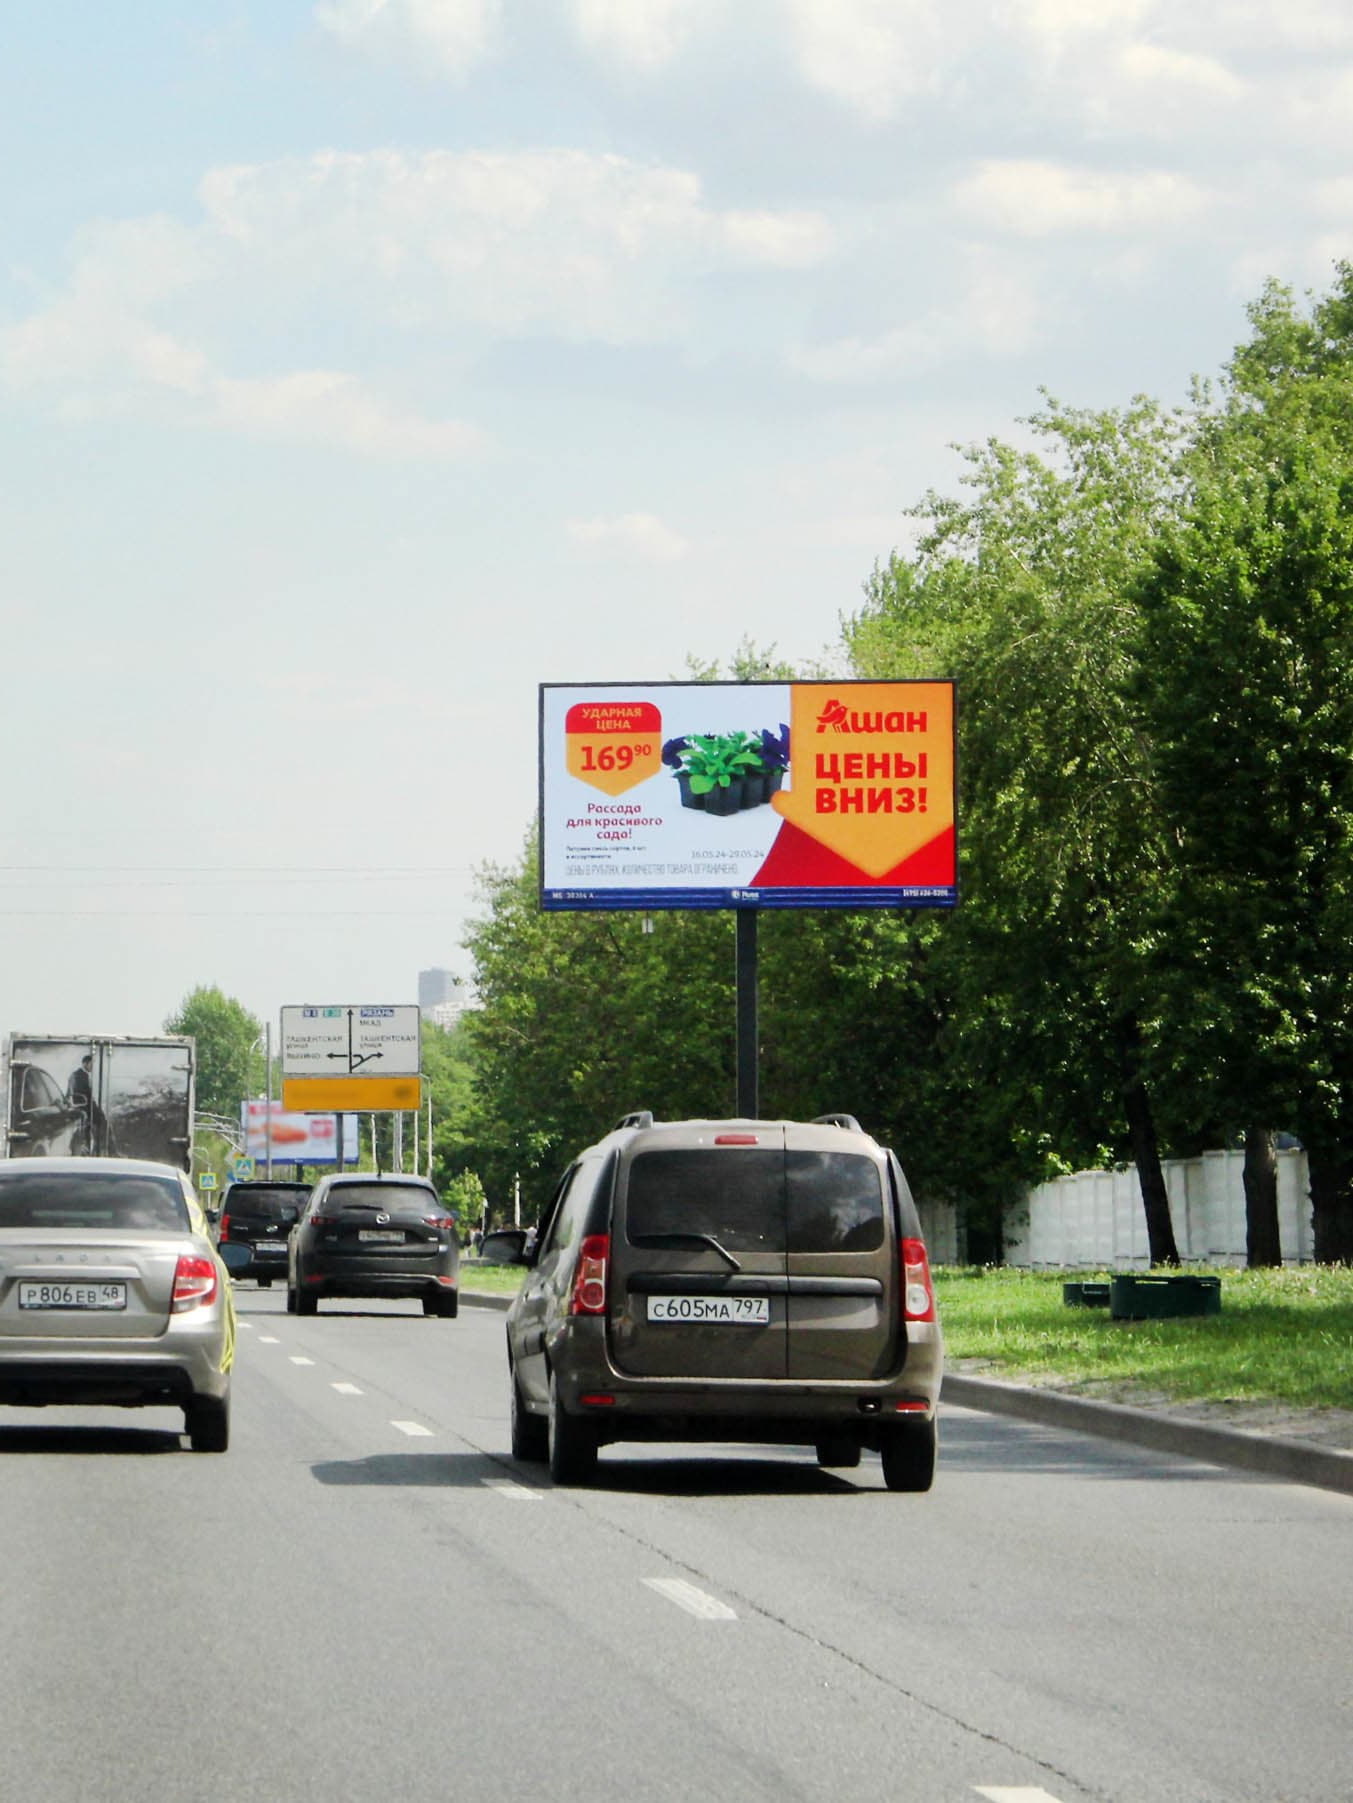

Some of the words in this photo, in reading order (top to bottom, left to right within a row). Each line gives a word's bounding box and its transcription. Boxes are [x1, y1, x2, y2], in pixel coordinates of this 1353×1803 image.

[582, 707, 642, 719] УДАРНАЯ
[816, 699, 927, 733] Ашан
[596, 719, 631, 730] ЦЕНА
[815, 752, 928, 784] ЦЕНЫ
[815, 787, 928, 814] ВНИЗ!
[587, 803, 642, 814] Рассада
[566, 818, 592, 828] для
[594, 816, 663, 829] красивого
[596, 829, 633, 840] сада!
